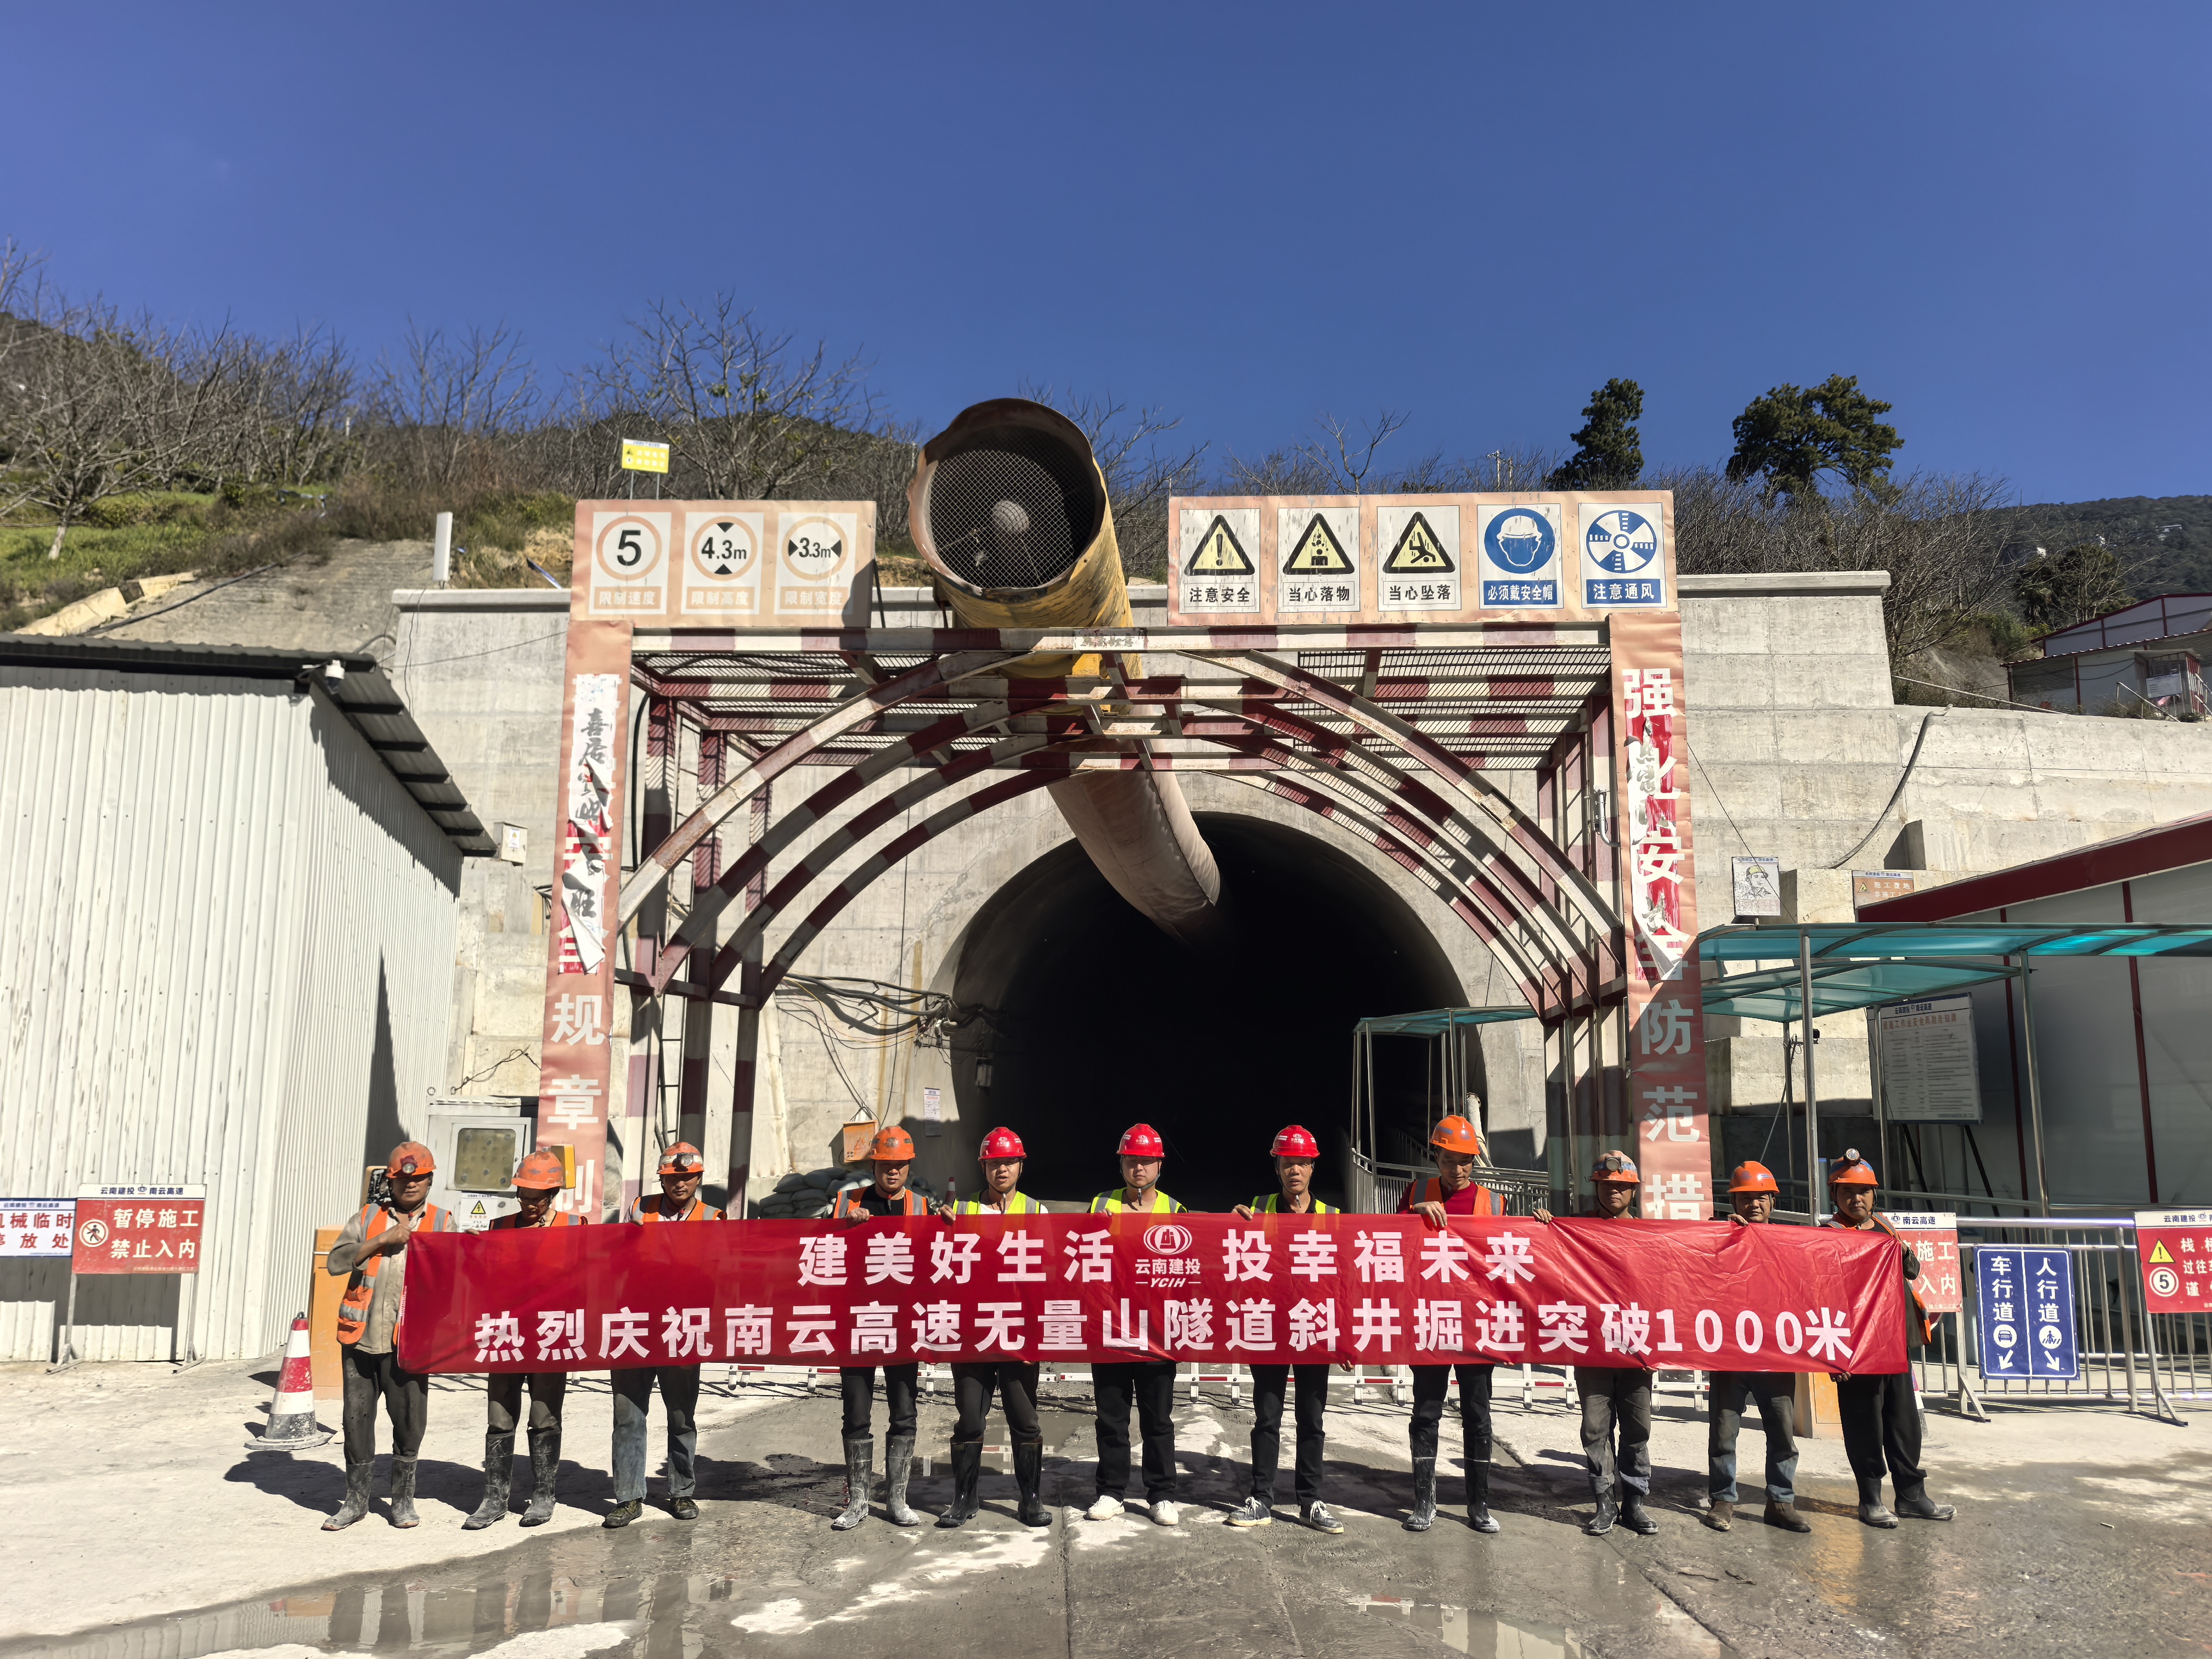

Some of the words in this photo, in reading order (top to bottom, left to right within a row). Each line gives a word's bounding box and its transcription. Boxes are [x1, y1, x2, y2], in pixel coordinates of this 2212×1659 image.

[617, 530, 642, 566] 5
[702, 537, 747, 560] 4.3m
[799, 537, 831, 558] 3.3m
[599, 591, 655, 605] 限制速度
[692, 591, 748, 606] 限制高度
[785, 591, 842, 606] 限制宽度
[1190, 587, 1250, 603] 注意安全
[1289, 586, 1350, 602] 当心落物
[1390, 585, 1451, 601] 当心坠落
[1488, 584, 1553, 601] 必须戴安全帽
[1593, 583, 1654, 599] 注意通风
[0, 1212, 73, 1229] 械临时
[113, 1208, 199, 1229] 暂停施工
[1903, 1216, 1936, 1225] 南云高速
[2163, 1215, 2196, 1223] 云南建投
[110, 1238, 195, 1259] 禁止入内
[1903, 1240, 1956, 1262] 施工
[798, 1229, 1114, 1286] 建美好生活
[1222, 1228, 1536, 1285] 投幸福未来
[1135, 1258, 1201, 1275] 云南建投
[2183, 1259, 2212, 1274] 过往
[1150, 1278, 1186, 1287] YCIH
[1991, 1256, 2015, 1321] 车行道
[2036, 1257, 2060, 1323] 人行道
[2159, 1274, 2170, 1290] 5
[2186, 1281, 2212, 1297] 谨
[474, 1297, 1854, 1363] 热烈庆祝南云高速无量山隧道斜井掘进突破1000米
